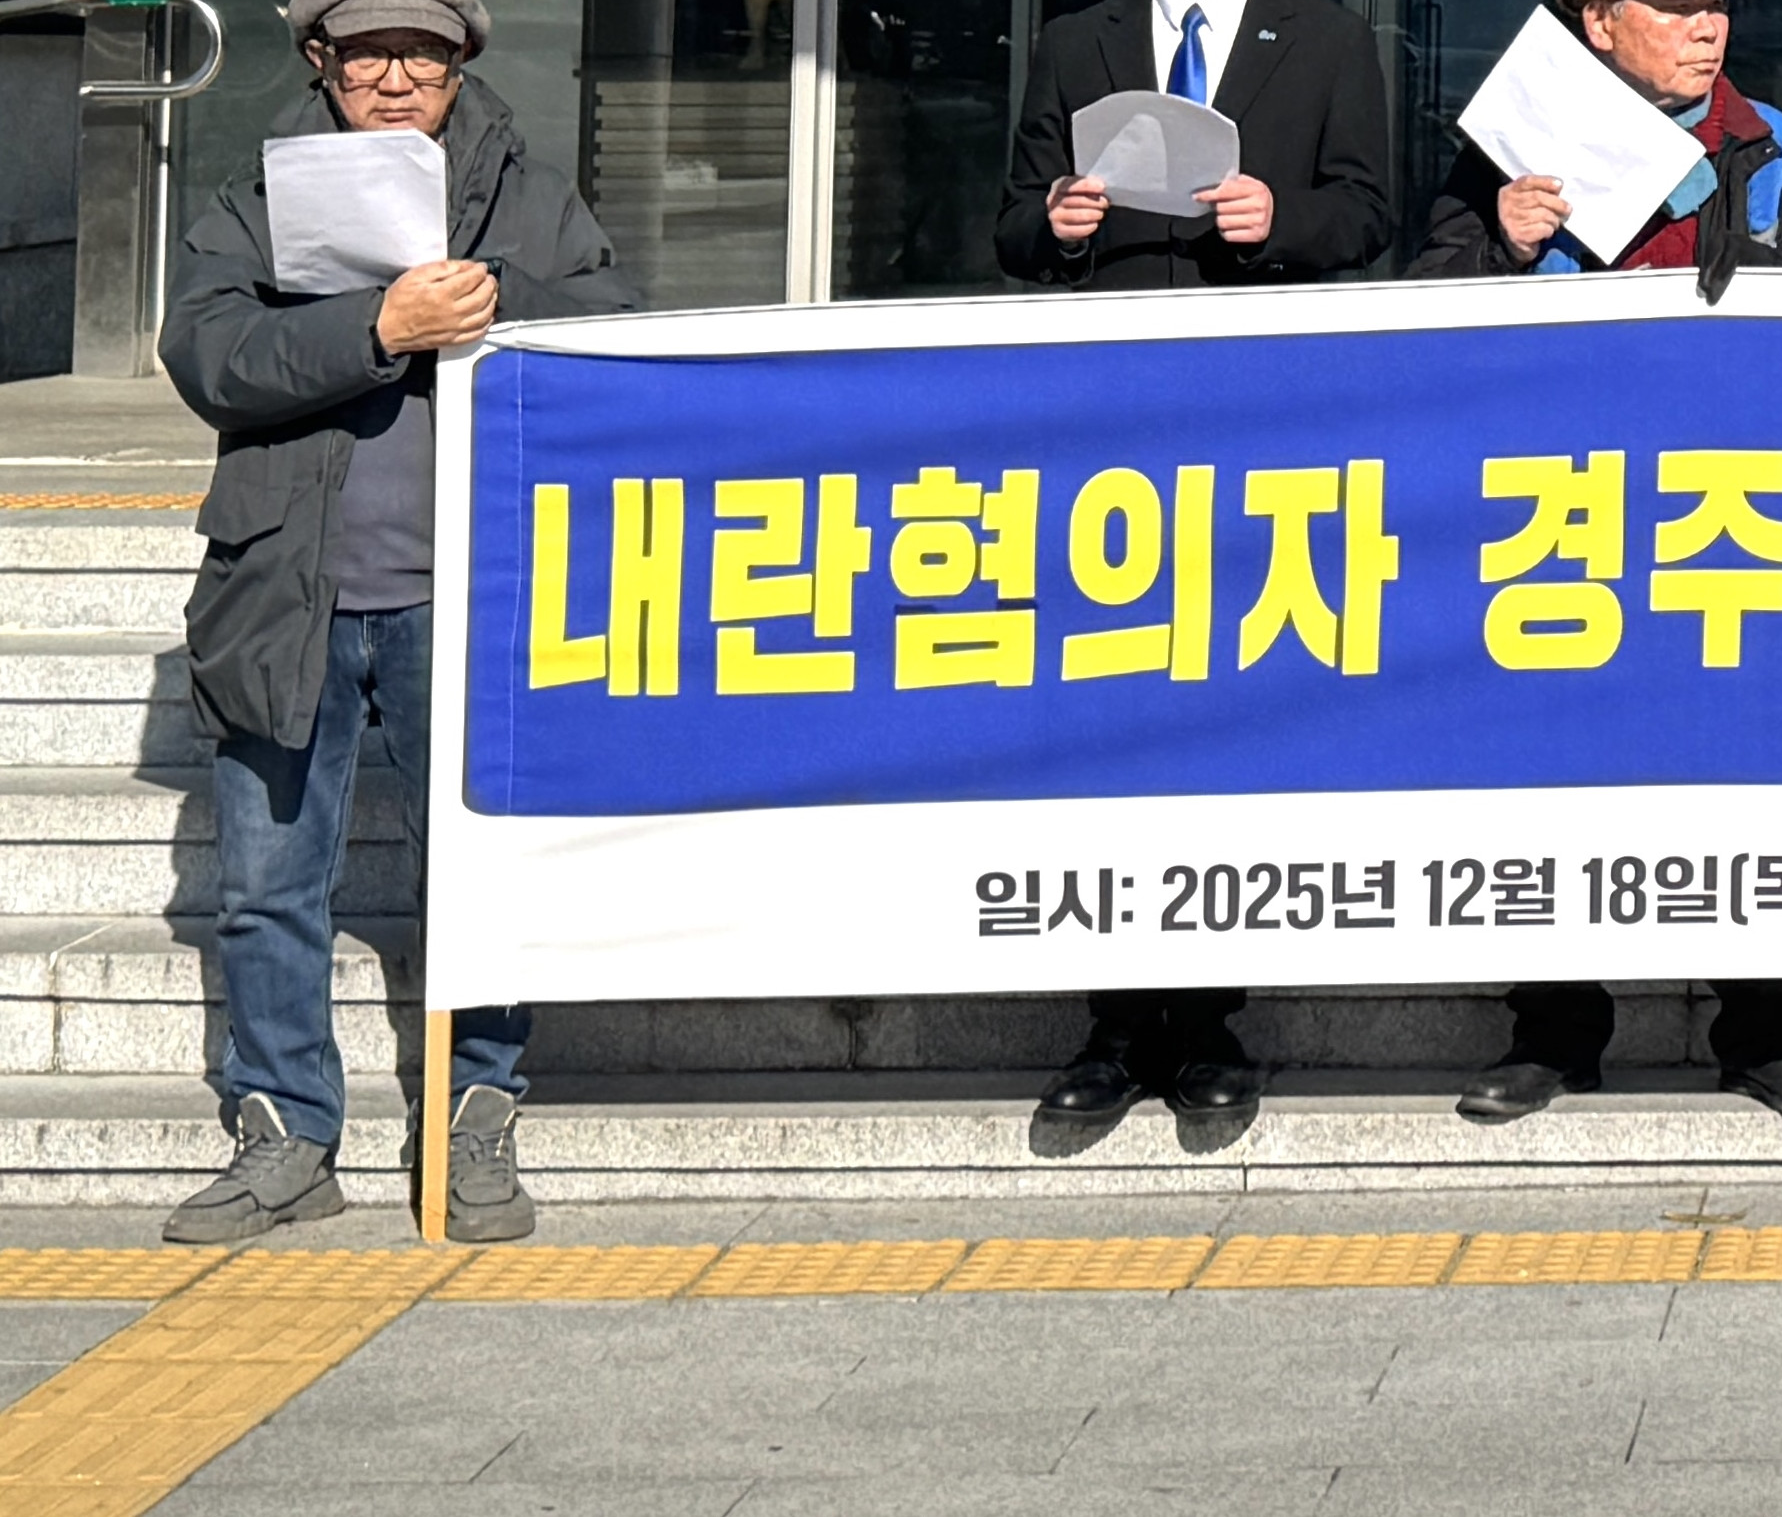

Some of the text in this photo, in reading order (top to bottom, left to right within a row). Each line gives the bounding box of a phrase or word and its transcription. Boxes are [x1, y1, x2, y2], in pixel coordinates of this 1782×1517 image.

[529, 459, 1400, 696] 내란혐의자
[974, 869, 1135, 937] 일시:
[1160, 859, 1397, 932] 2025년
[1420, 855, 1558, 927] 12월
